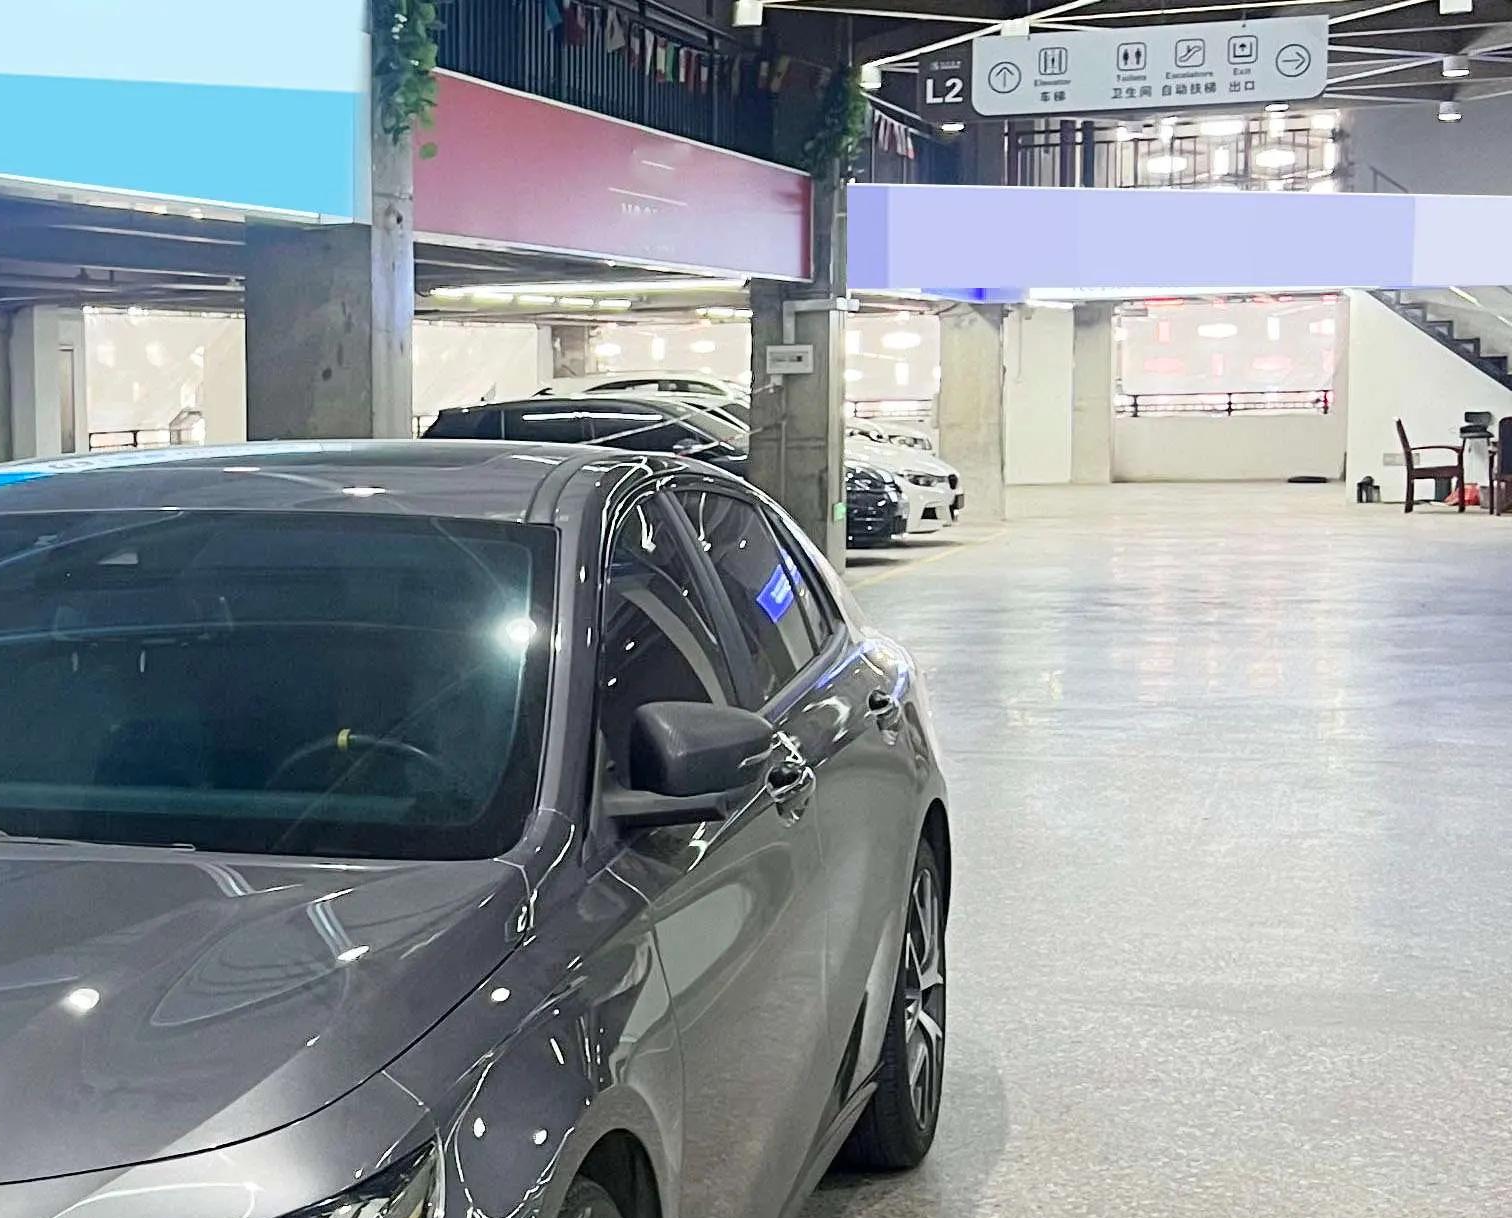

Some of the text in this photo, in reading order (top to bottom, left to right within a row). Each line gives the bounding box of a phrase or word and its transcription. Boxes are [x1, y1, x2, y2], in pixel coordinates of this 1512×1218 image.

[926, 78, 964, 104] L2
[1111, 86, 1153, 99] 卫生间
[1161, 81, 1217, 97] 自动扶梯
[1228, 80, 1255, 93] 出口
